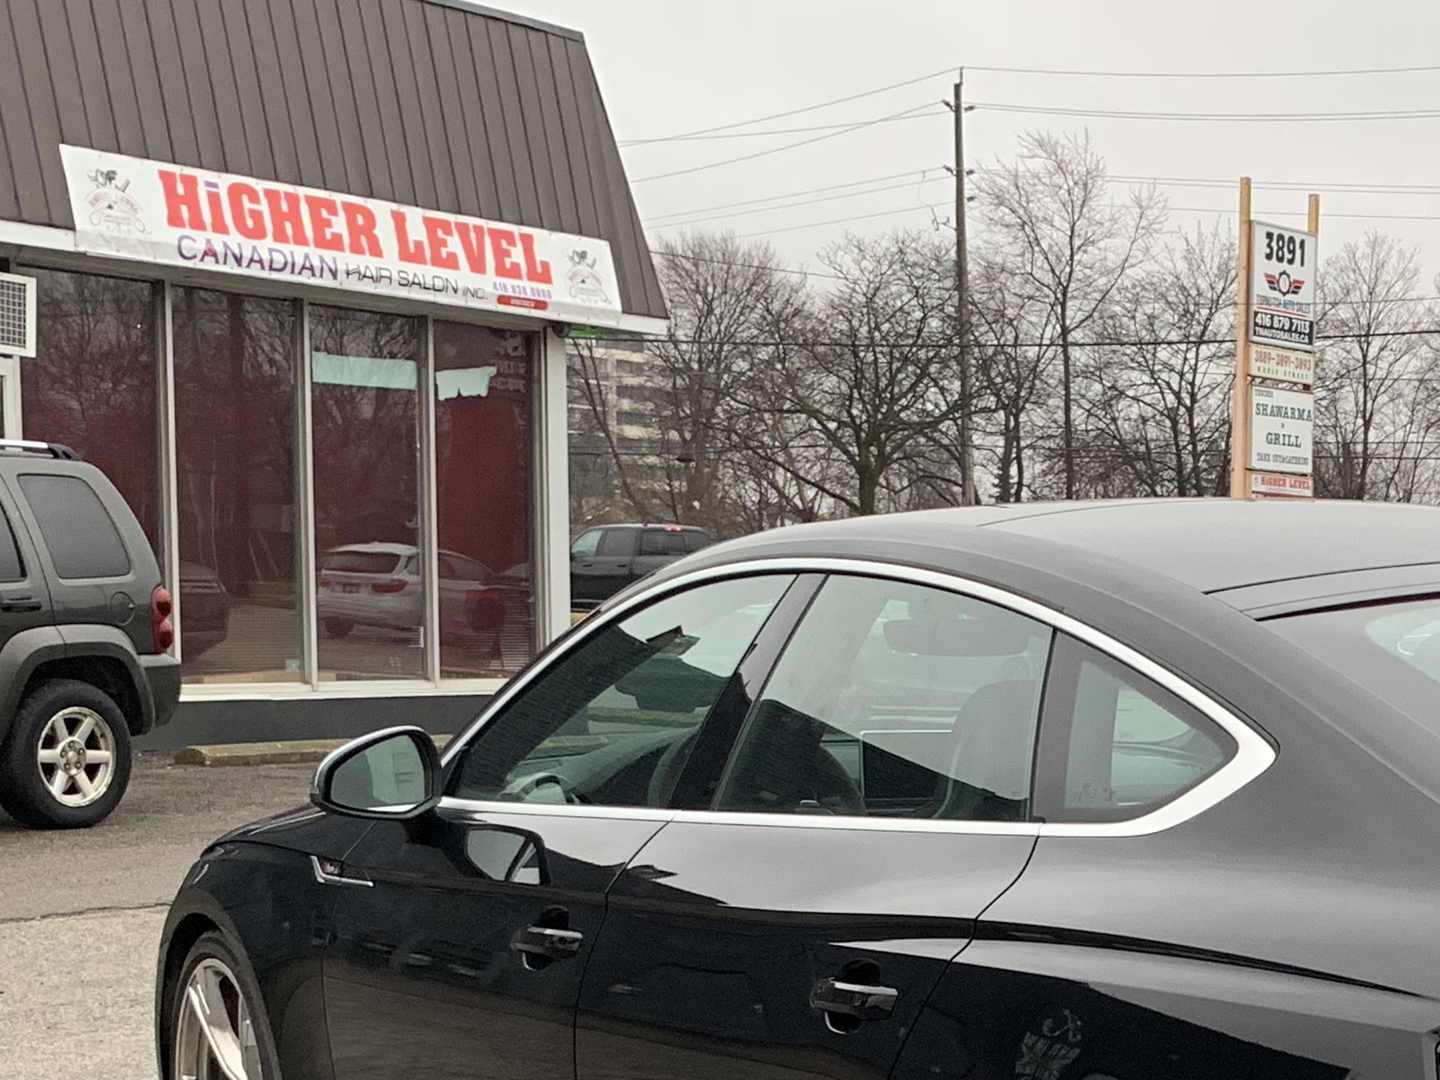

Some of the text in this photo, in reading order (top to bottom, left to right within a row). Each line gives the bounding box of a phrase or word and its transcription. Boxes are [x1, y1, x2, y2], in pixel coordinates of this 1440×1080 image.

[390, 210, 553, 286] LEVEL
[1264, 231, 1306, 268] 3891
[176, 234, 339, 281] CANADIAN
[345, 261, 393, 286] HAIR
[396, 269, 459, 296] SALON
[1255, 312, 1310, 334] 416 879 7113
[1255, 403, 1312, 422] SHAWARMA
[1266, 432, 1302, 448] GRILL
